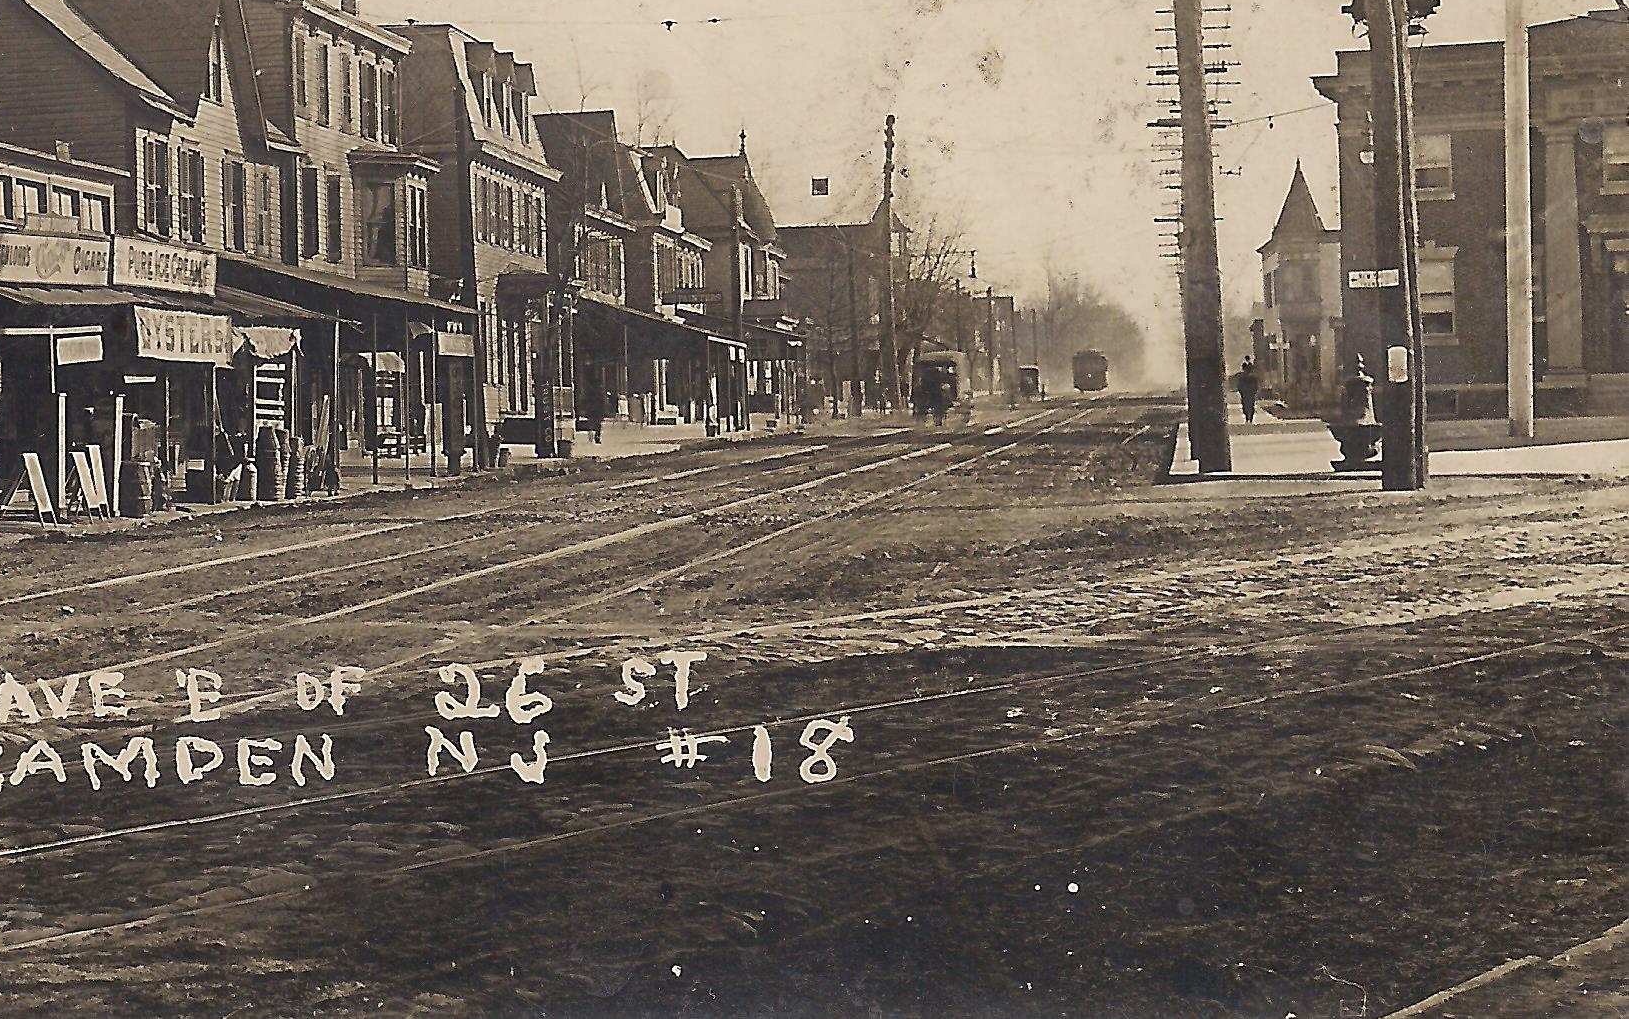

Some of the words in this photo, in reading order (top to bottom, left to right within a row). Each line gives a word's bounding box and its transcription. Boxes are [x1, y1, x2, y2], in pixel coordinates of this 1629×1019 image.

[73, 246, 107, 274] CIGARS
[128, 245, 153, 281] PURE
[154, 249, 170, 283] ICE
[171, 252, 204, 288] CREAM
